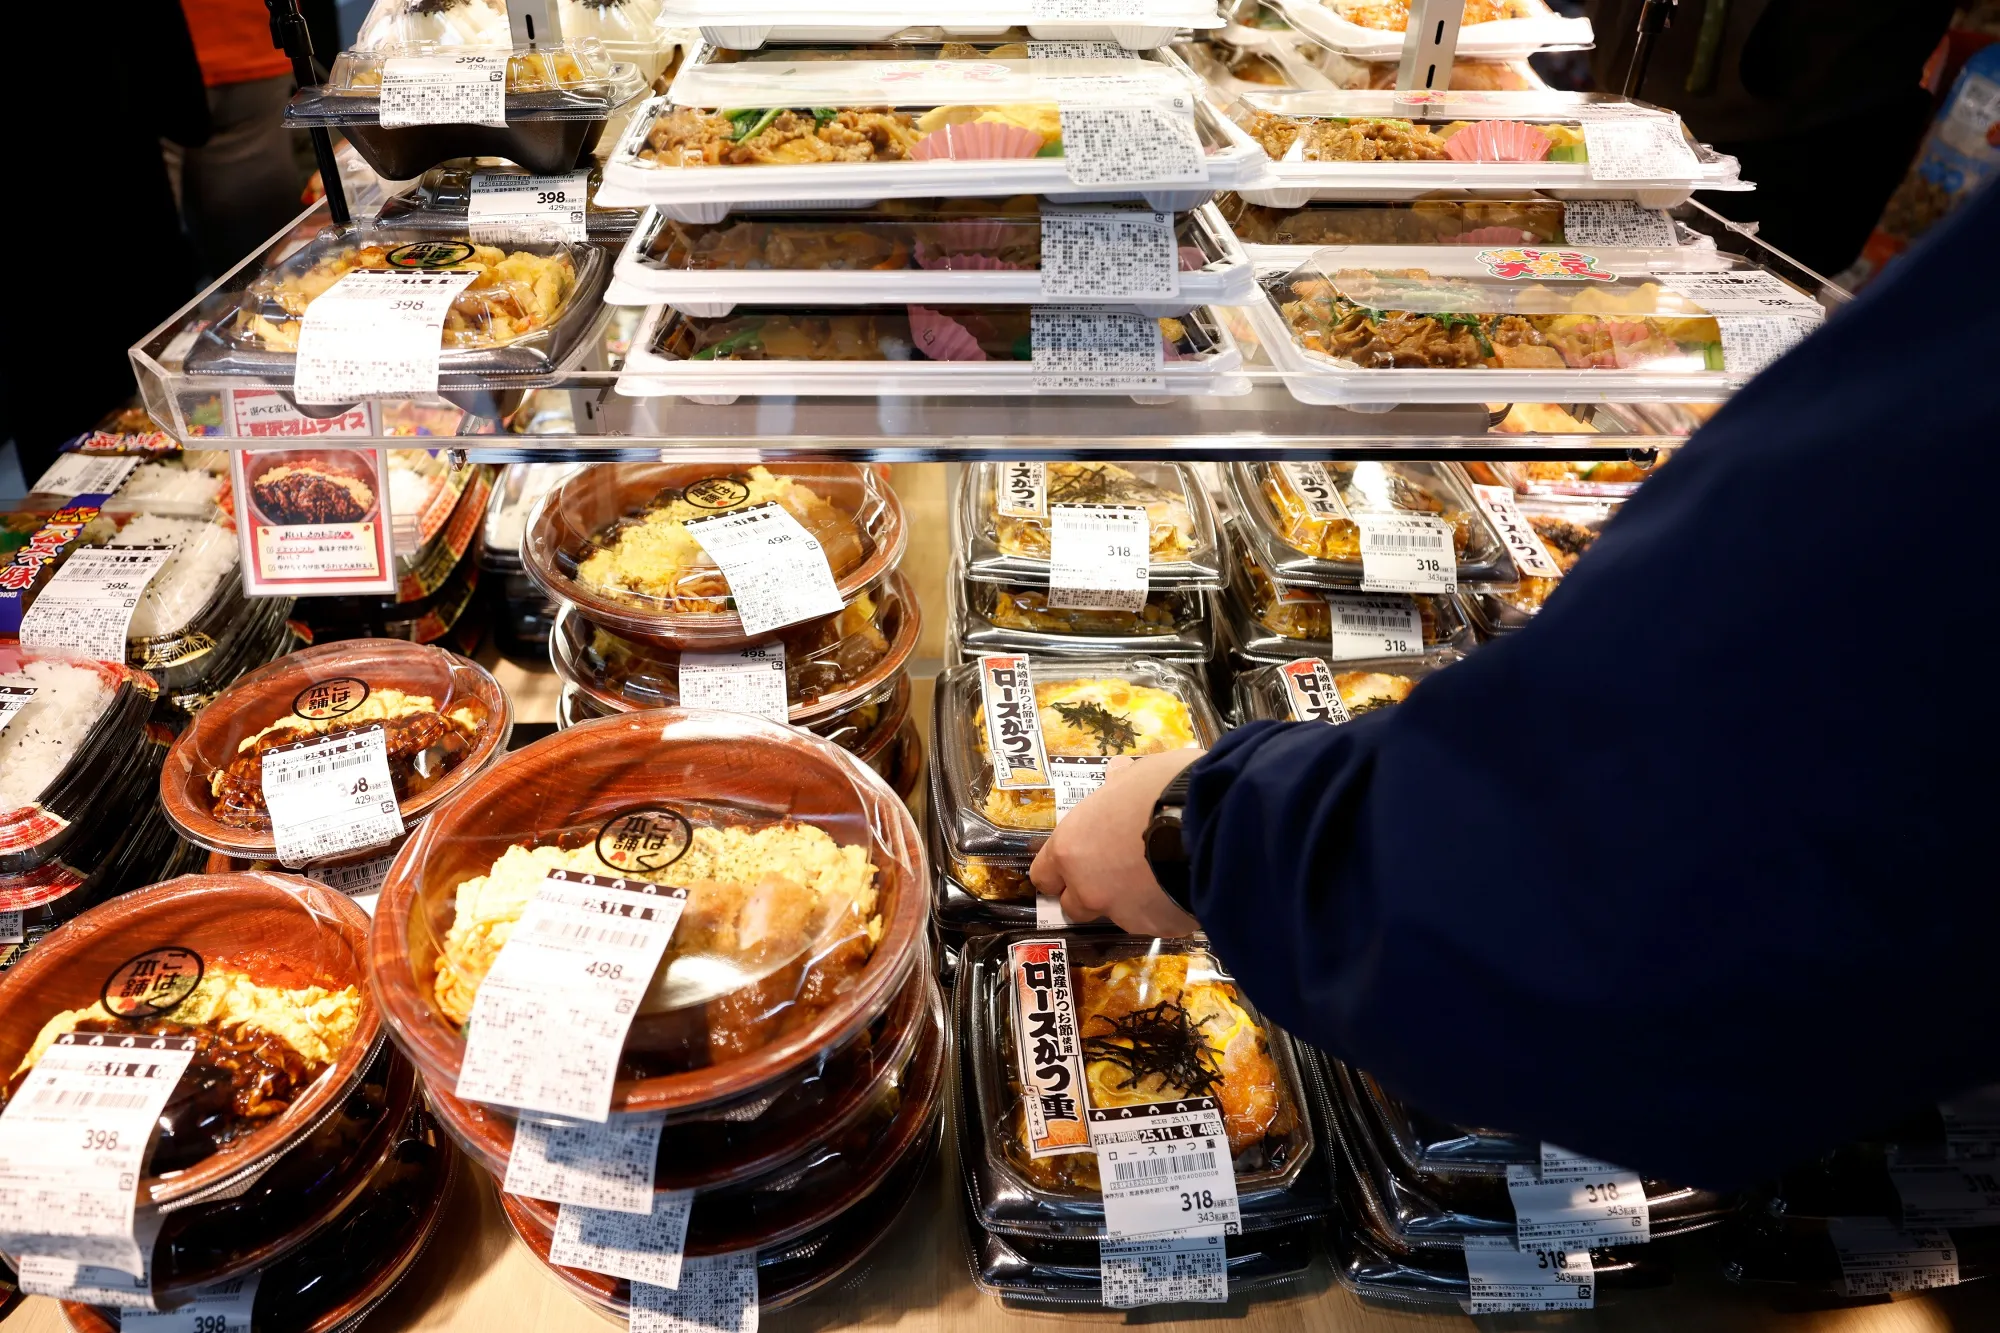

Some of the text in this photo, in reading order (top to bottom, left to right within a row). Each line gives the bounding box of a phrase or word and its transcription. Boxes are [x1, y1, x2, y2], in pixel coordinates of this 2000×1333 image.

[537, 192, 566, 204] 398
[390, 300, 424, 310] 398
[768, 535, 792, 545] 498
[1107, 545, 1131, 557] 318
[1416, 559, 1440, 572] 318
[1428, 573, 1440, 581] 343
[102, 582, 129, 590] 398
[1384, 639, 1407, 652] 318
[740, 650, 766, 658] 498
[991, 669, 1038, 771] ロースかつ重
[355, 794, 371, 805] 429
[585, 961, 623, 980] 498
[1051, 950, 1074, 1054] 枕崎産かつお節使用
[1022, 961, 1079, 1121] ロースかつ重
[1172, 1116, 1191, 1124] 25.11.
[1193, 1114, 1198, 1122] 7
[82, 1129, 119, 1150] 398
[1094, 1121, 1223, 1146] 消費期限 25.11. 8 4時
[1109, 1139, 1216, 1161] ロースかつ重
[1585, 1182, 1619, 1203] 318
[1181, 1190, 1213, 1212] 318
[1198, 1211, 1215, 1224] 343
[1607, 1205, 1624, 1217] 343
[1537, 1249, 1569, 1269] 318
[1554, 1272, 1572, 1283] 343
[194, 1315, 227, 1333] 398
